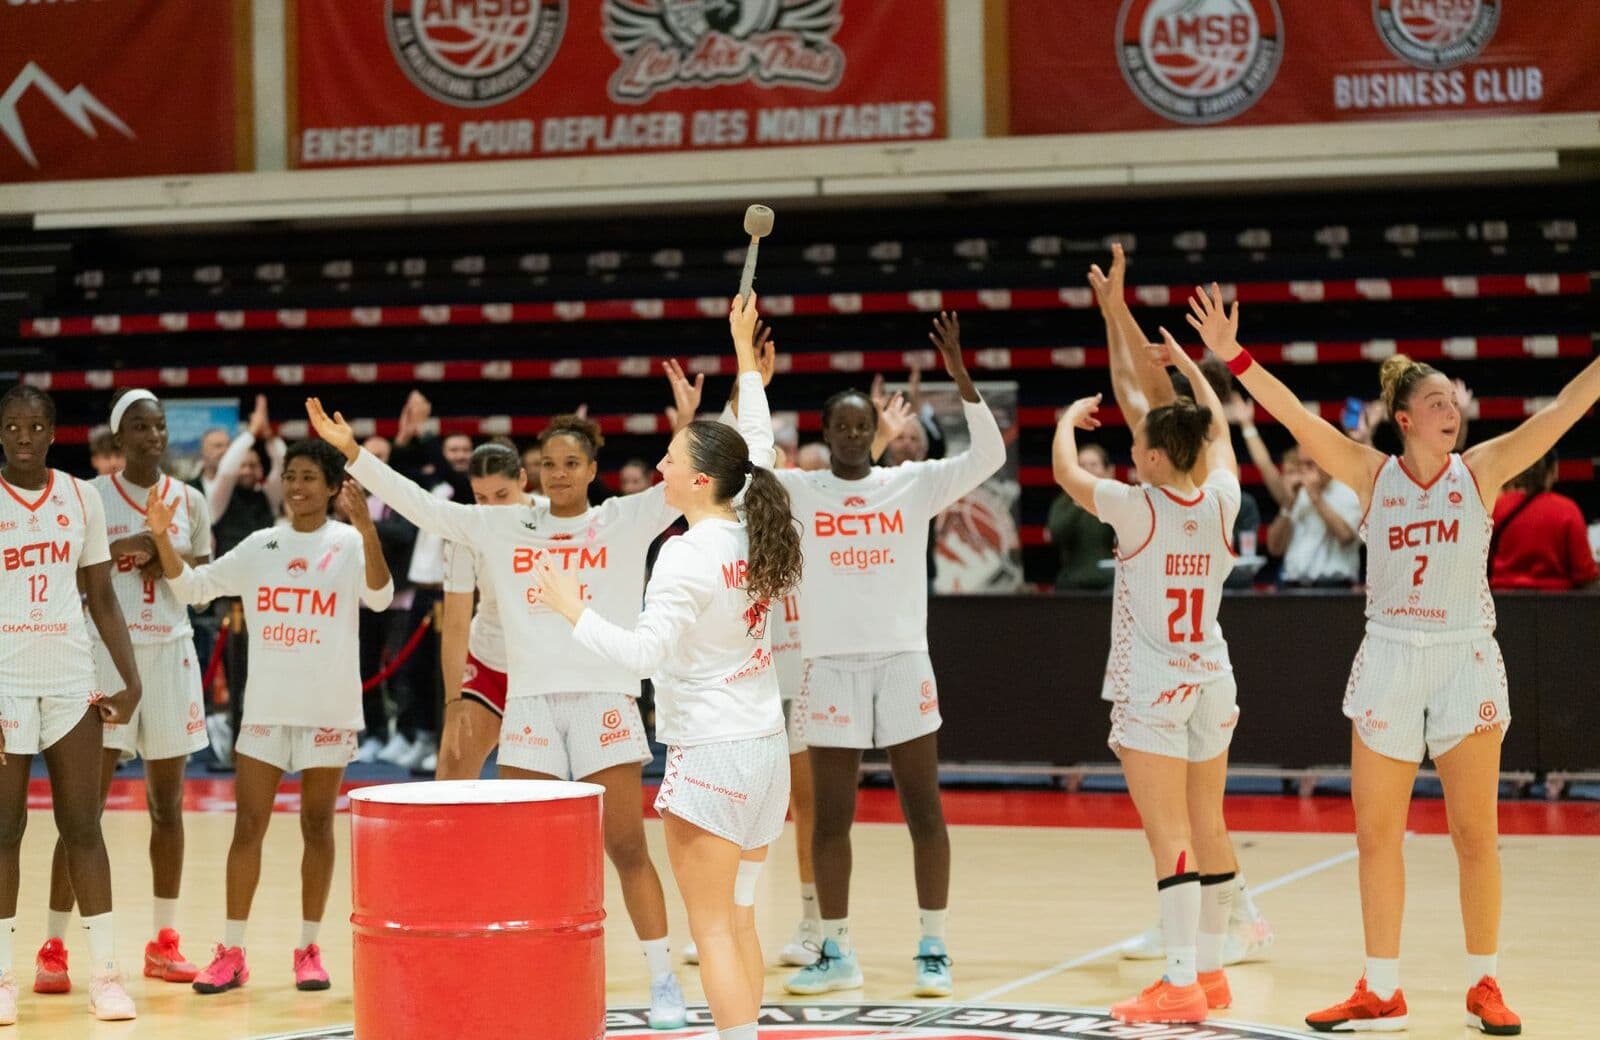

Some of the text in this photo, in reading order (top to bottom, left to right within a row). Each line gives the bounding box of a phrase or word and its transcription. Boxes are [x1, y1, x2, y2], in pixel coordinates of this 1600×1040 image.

[1151, 13, 1250, 48] AMSB
[1335, 67, 1543, 108] BUSINESS CLUB
[459, 119, 534, 154] POUR
[541, 113, 684, 151] DEPLACER
[692, 110, 748, 145] DES
[757, 102, 934, 143] MONTAGNES
[815, 511, 904, 537] BCTM
[1388, 519, 1459, 551] BCTM
[4, 540, 70, 571] BCTM
[829, 546, 895, 570] edgar.
[1165, 554, 1211, 577] DESSET
[1412, 555, 1428, 586] 2
[28, 574, 49, 603] 12
[257, 586, 337, 617] BCTM
[1166, 588, 1205, 643] 21
[262, 623, 321, 647] edgar.
